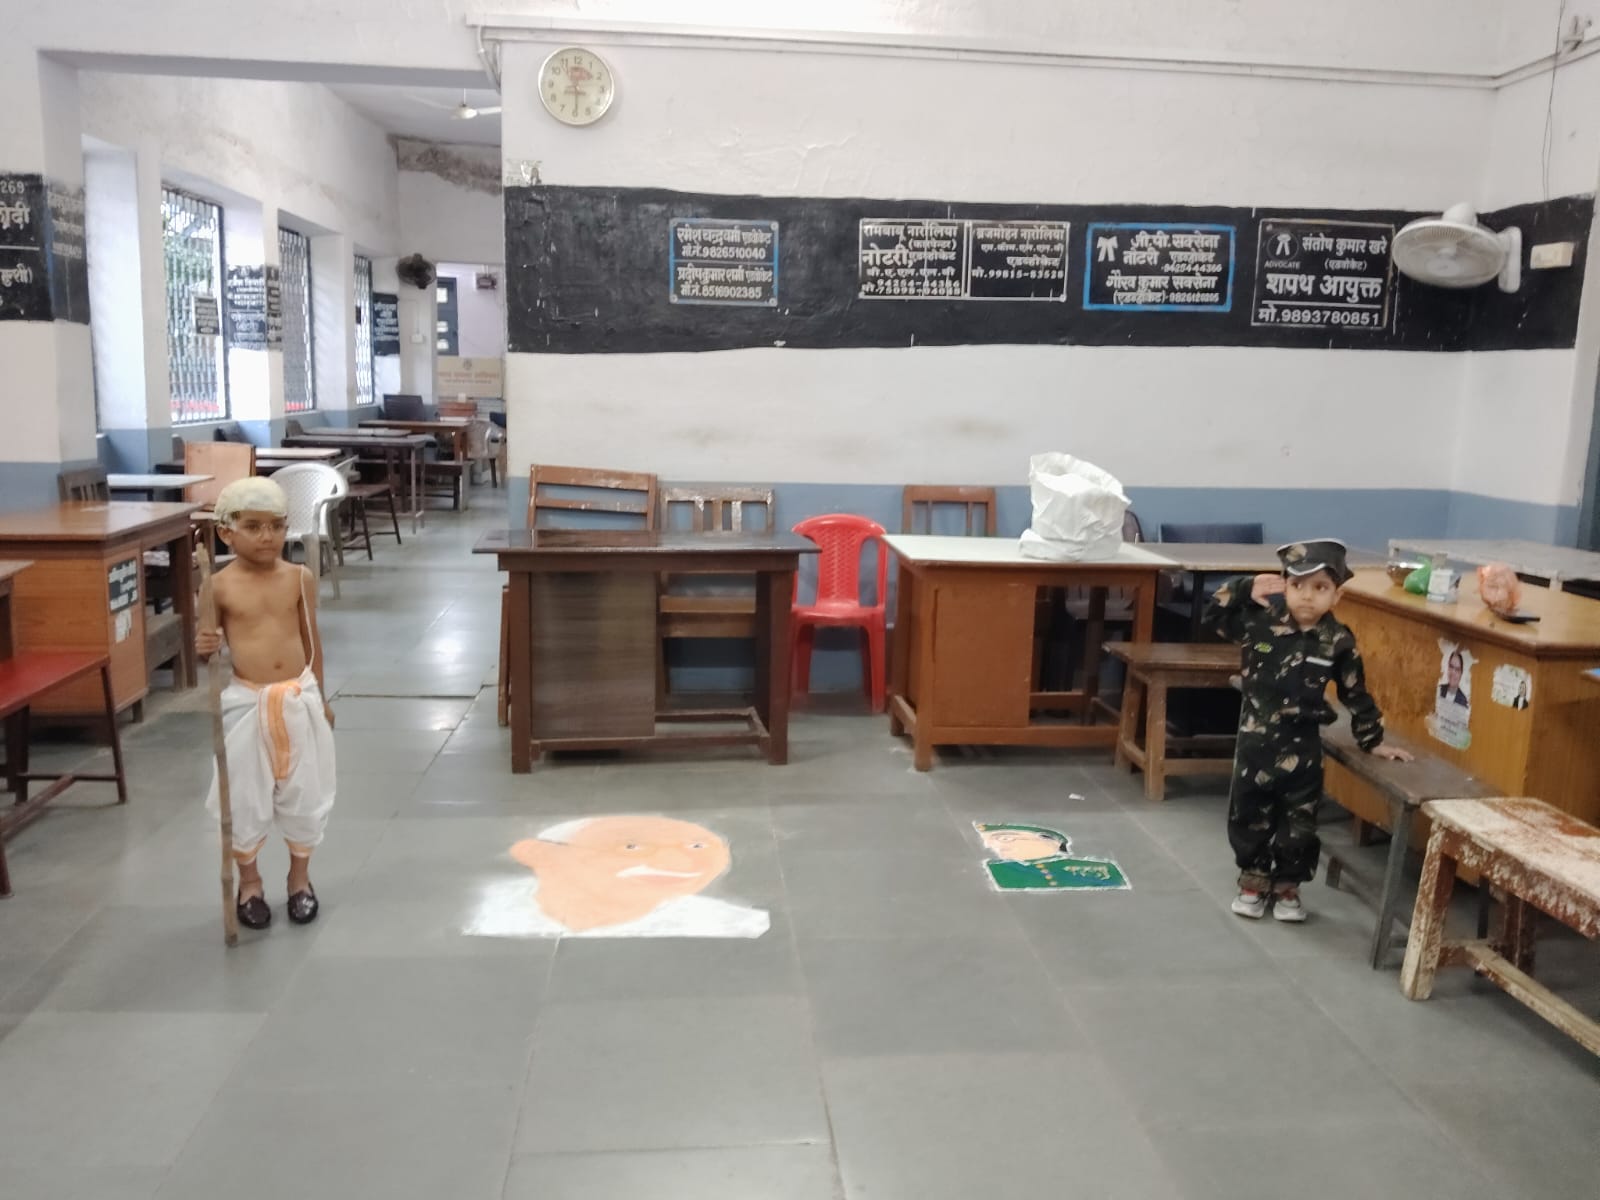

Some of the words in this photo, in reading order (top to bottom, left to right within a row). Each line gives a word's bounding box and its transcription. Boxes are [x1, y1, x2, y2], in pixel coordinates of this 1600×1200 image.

[1302, 232, 1335, 252] संतोष
[1336, 238, 1367, 256] कुमार
[1368, 235, 1388, 255] खरे
[1264, 260, 1301, 270] ADVOCATE
[1266, 273, 1316, 296] शपथ
[1320, 274, 1384, 304] आयुक्त
